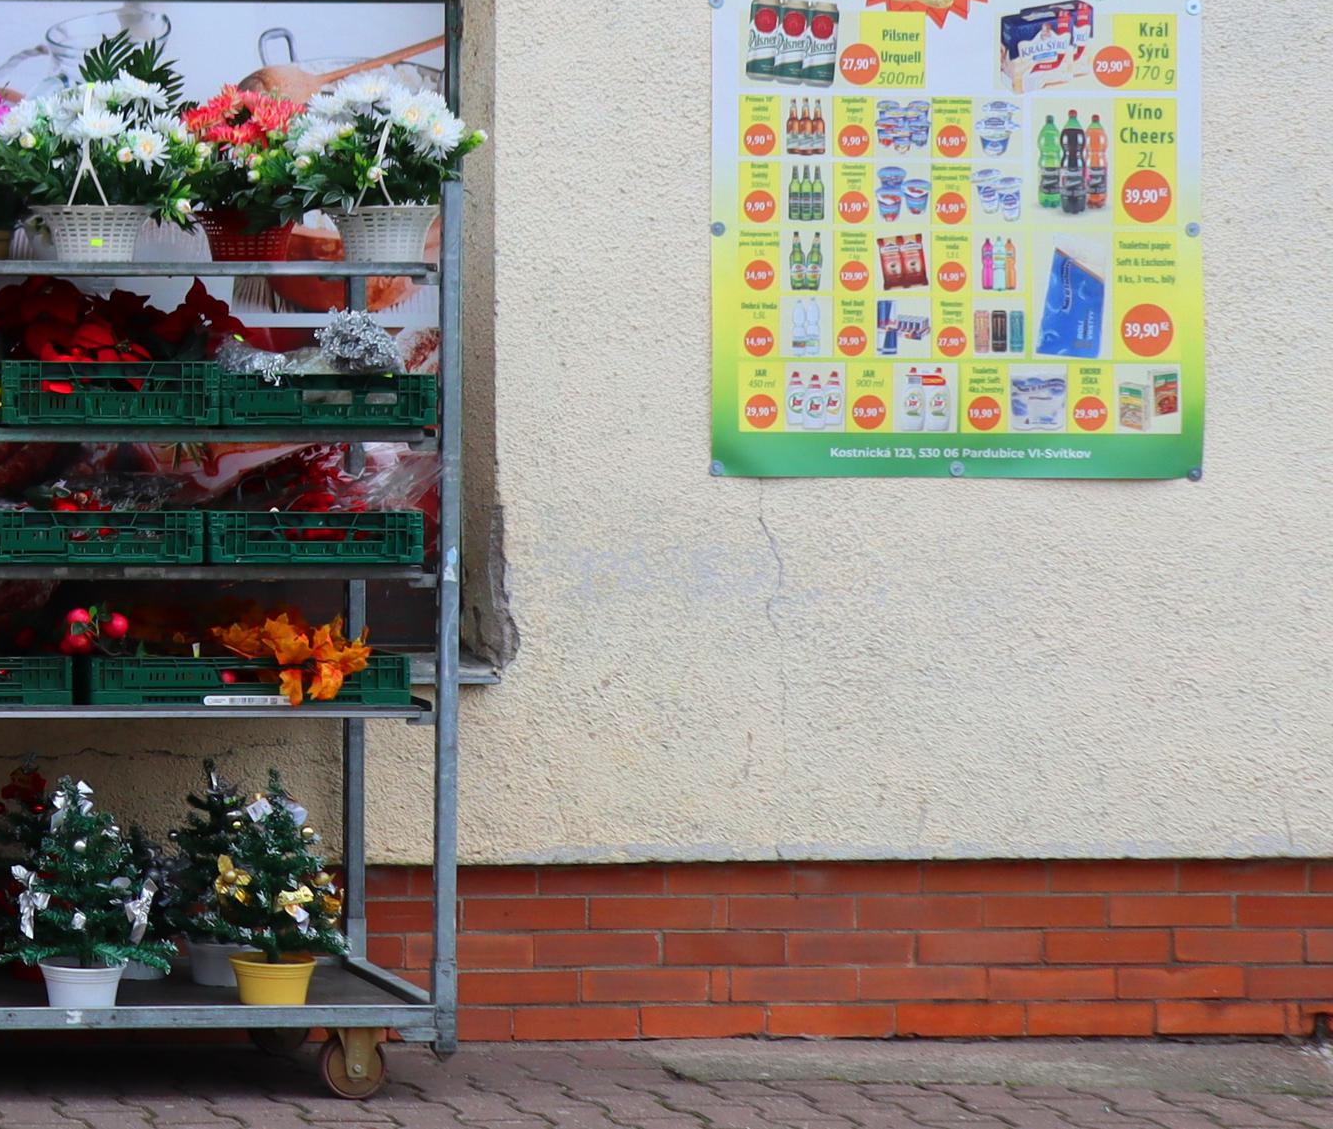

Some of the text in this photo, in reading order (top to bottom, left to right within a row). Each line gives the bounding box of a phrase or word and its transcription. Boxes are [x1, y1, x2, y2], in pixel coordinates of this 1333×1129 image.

[882, 29, 921, 42] Pilsner
[1139, 22, 1169, 38] Král
[881, 51, 921, 66] Urquell
[1138, 43, 1170, 62] Sýrů
[842, 57, 869, 72] 27,90
[1096, 60, 1123, 74] 29,90
[877, 71, 925, 85] 500ml
[1135, 66, 1176, 84] 170 g
[1127, 103, 1163, 120] Víno
[1119, 127, 1175, 144] Cheers
[1136, 151, 1157, 168] 2L
[1124, 188, 1159, 205] 39,90
[1124, 322, 1159, 339] 39,90
[830, 446, 892, 458] Kostnická
[894, 448, 916, 460] 123,
[918, 448, 941, 459] 530
[943, 448, 959, 459] 06
[961, 447, 1026, 459] Pardubice
